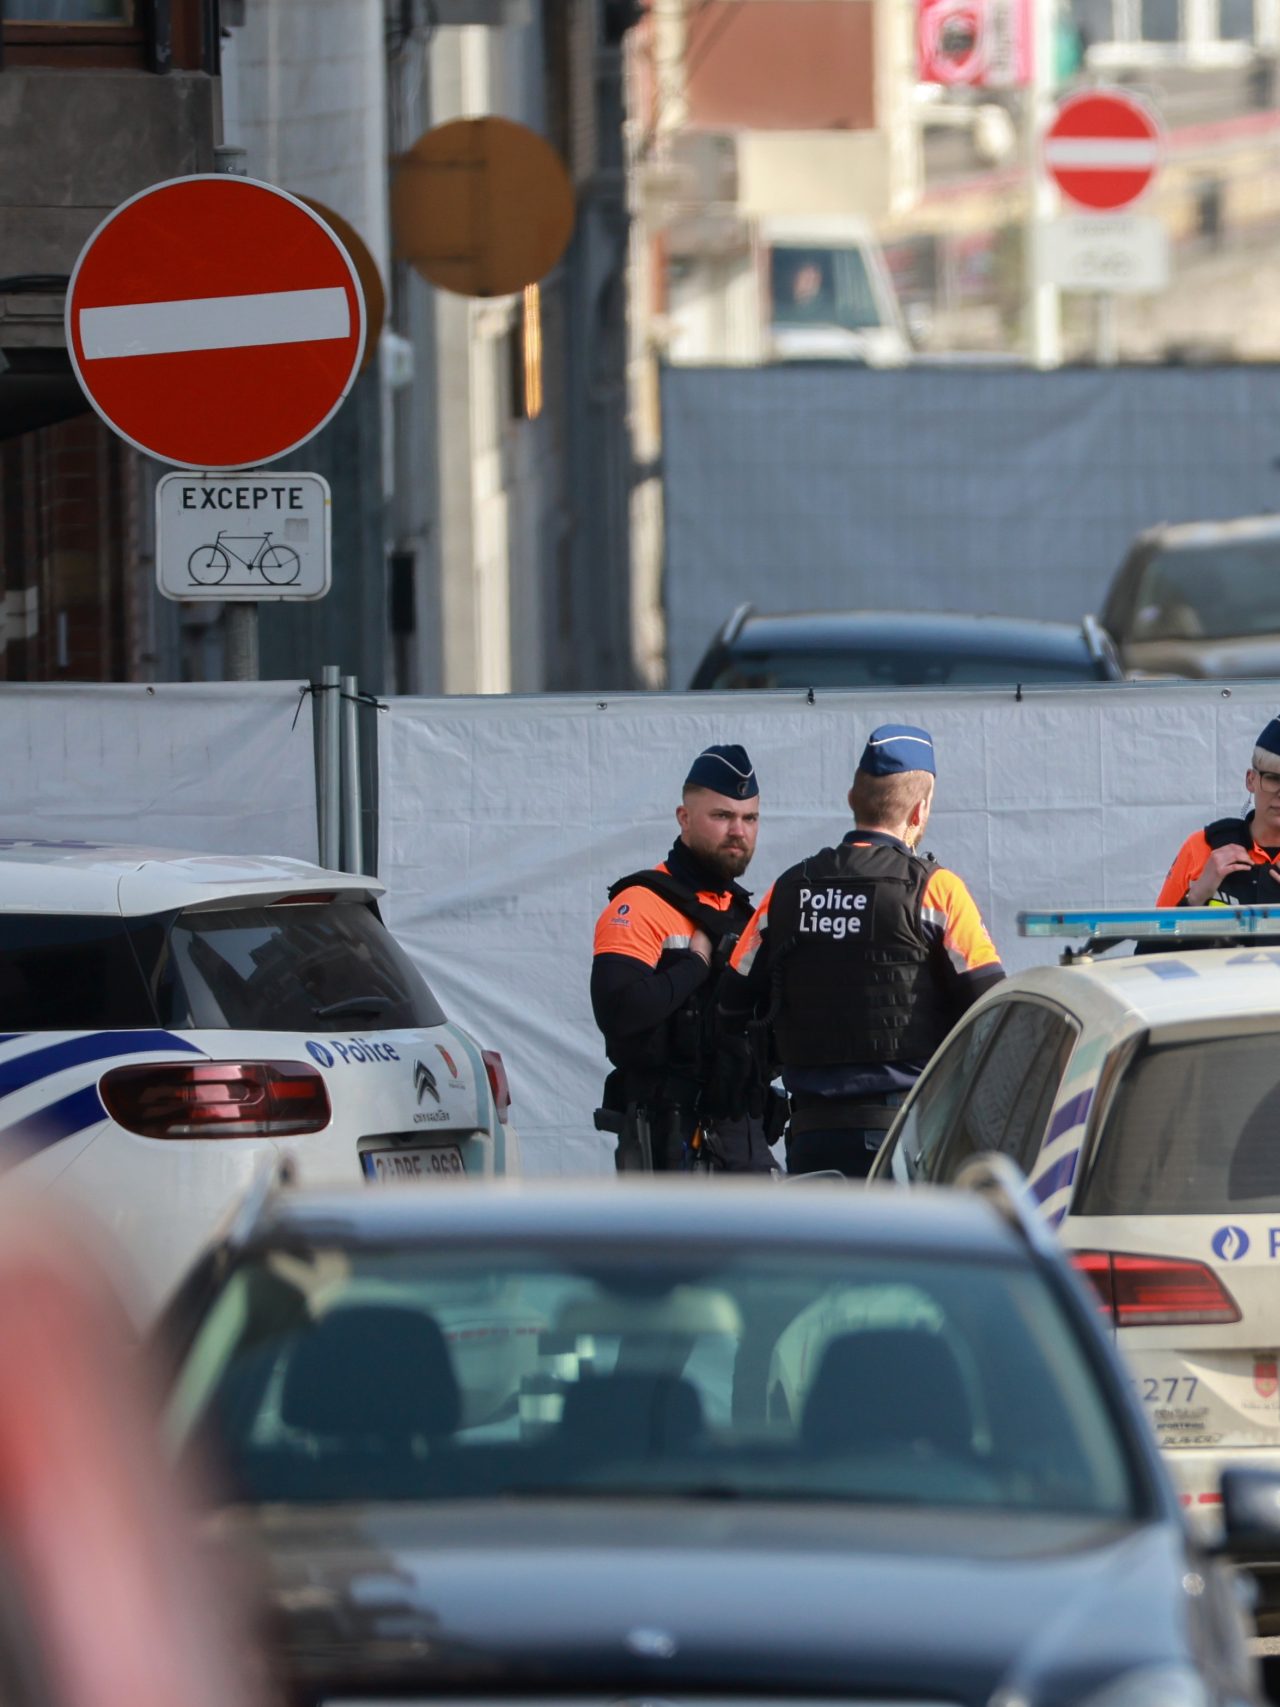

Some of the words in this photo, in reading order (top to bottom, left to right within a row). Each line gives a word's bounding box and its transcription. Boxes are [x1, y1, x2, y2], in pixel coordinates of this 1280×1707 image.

[182, 487, 303, 510] EXCEPTE
[799, 888, 867, 910] Police
[799, 911, 861, 939] Liege
[329, 1037, 401, 1065] Police
